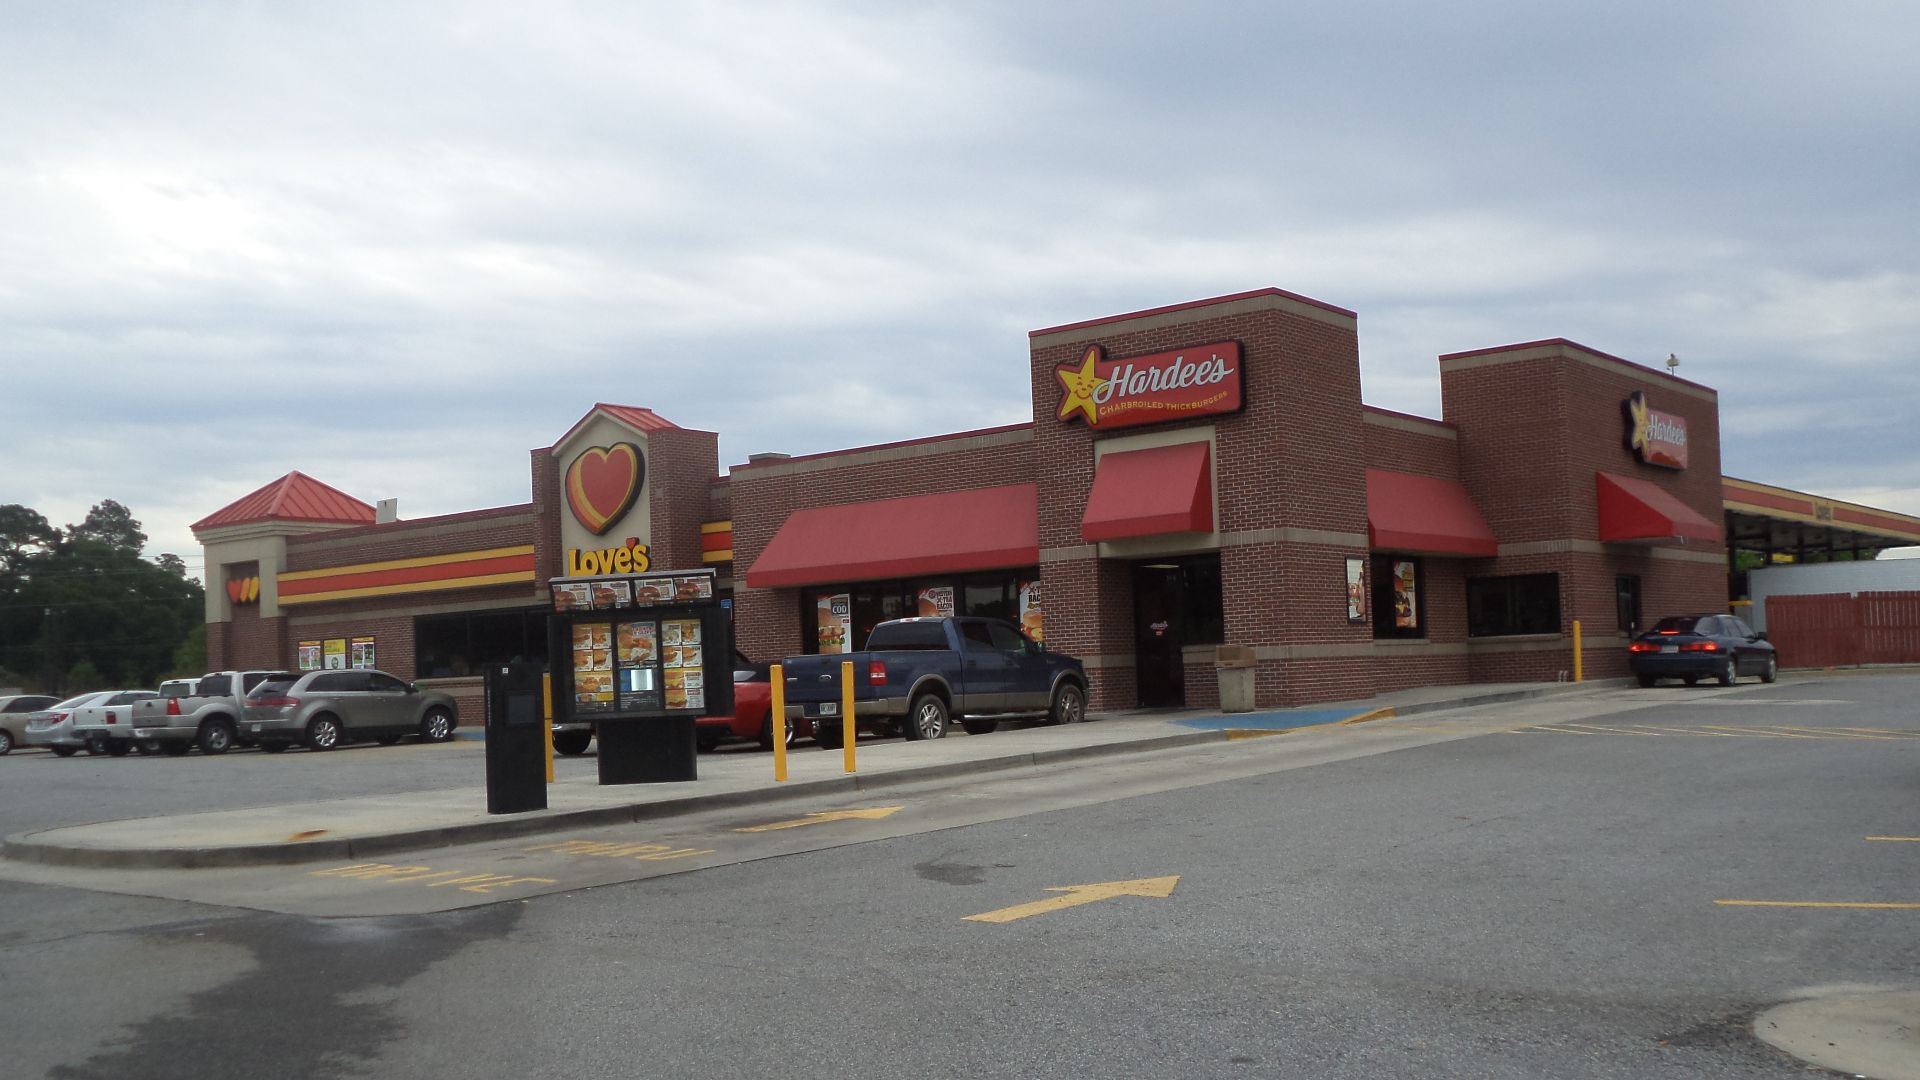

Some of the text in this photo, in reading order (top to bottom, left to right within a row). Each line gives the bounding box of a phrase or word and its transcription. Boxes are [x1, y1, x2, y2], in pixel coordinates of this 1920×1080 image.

[1092, 354, 1234, 404] Hardee's
[1100, 391, 1229, 415] CHARBROILED THICKBURGERS
[832, 605, 847, 614] COD
